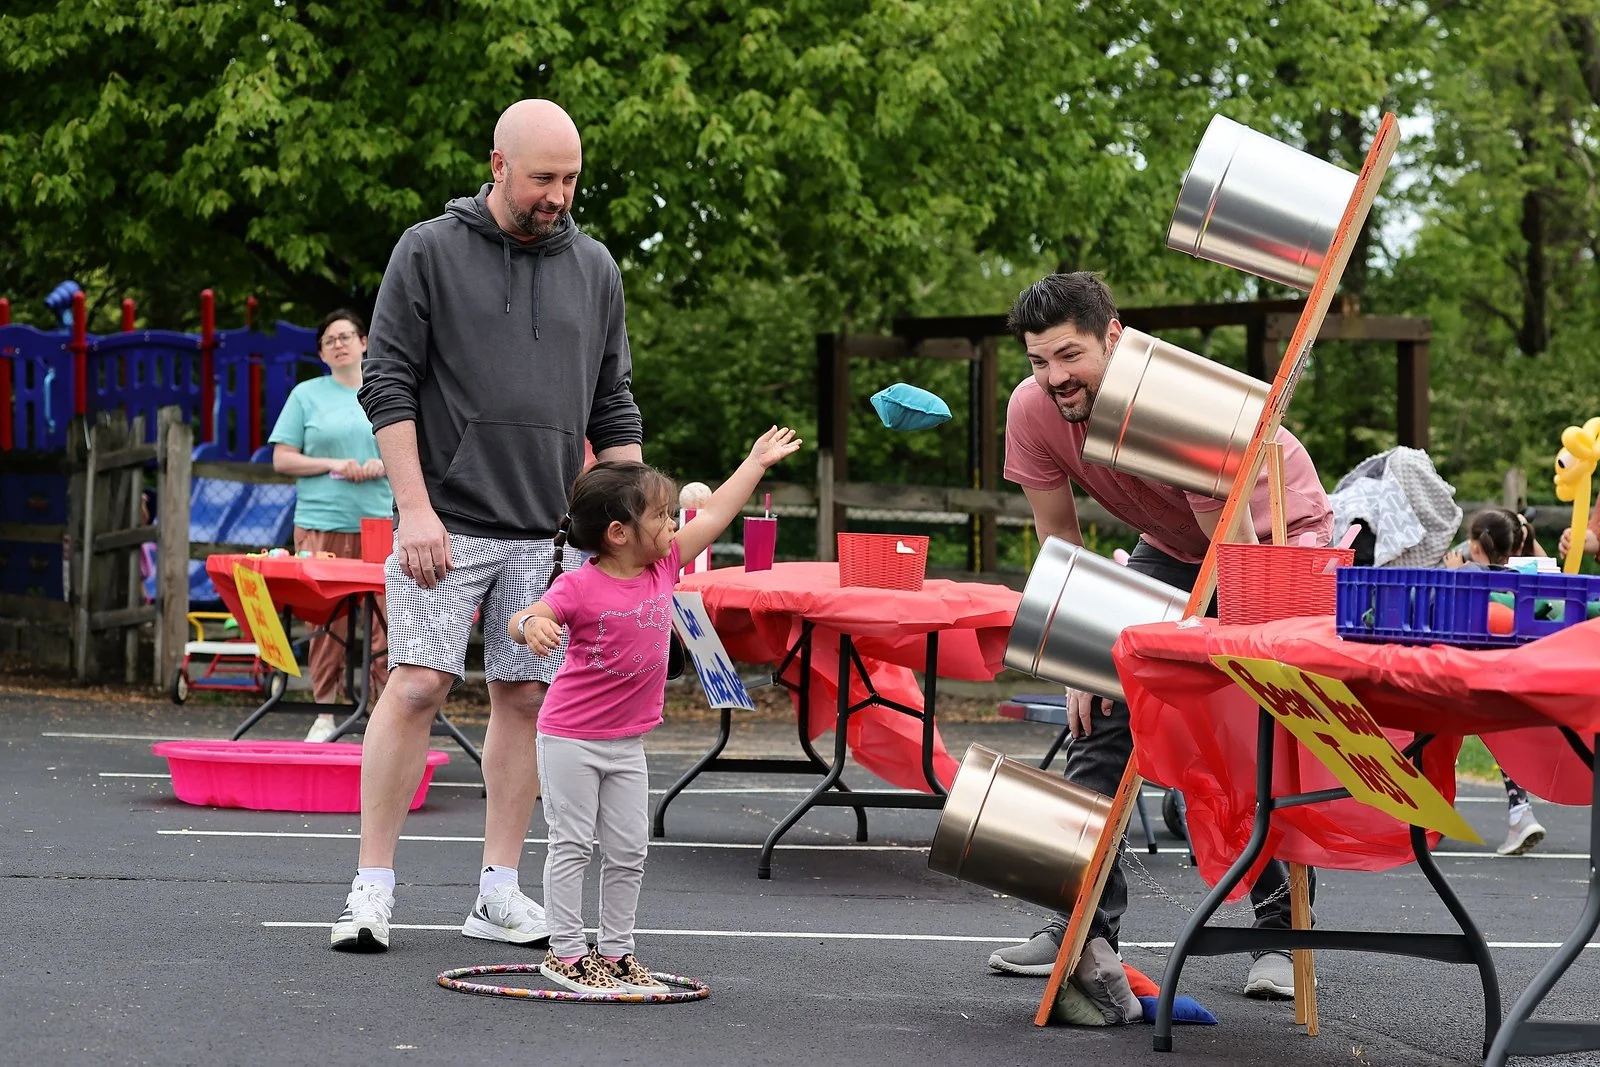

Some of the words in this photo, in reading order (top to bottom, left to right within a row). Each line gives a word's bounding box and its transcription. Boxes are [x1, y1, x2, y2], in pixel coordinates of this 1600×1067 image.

[672, 595, 705, 640] Can
[1228, 660, 1330, 725] Bean
[1300, 671, 1418, 779] Bag
[1313, 731, 1419, 810] Toss
